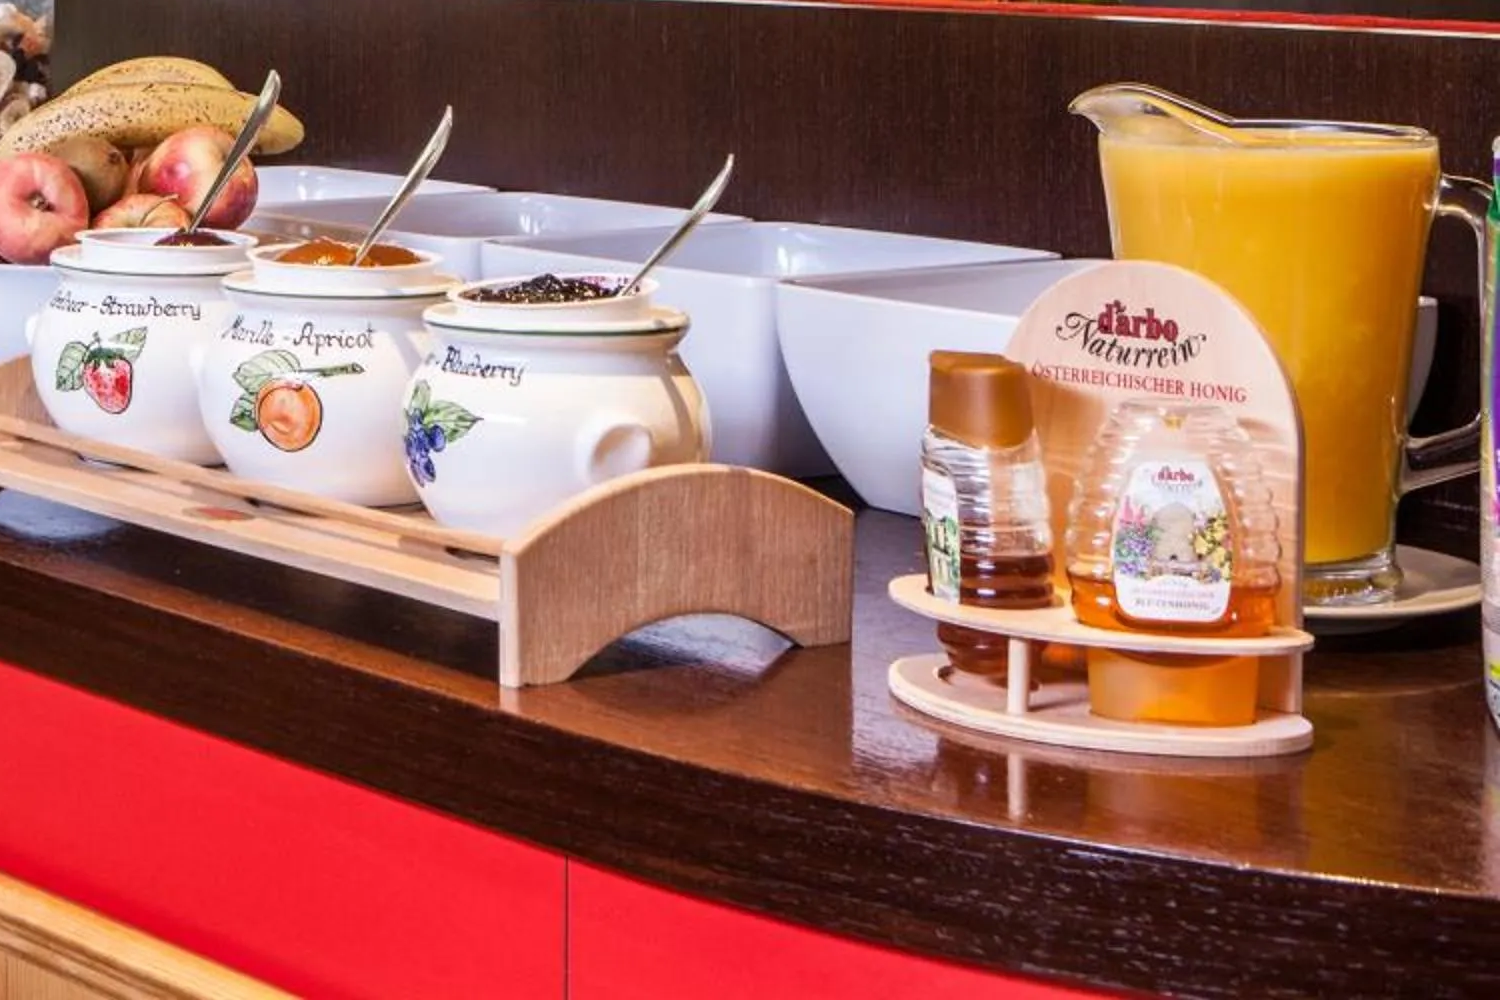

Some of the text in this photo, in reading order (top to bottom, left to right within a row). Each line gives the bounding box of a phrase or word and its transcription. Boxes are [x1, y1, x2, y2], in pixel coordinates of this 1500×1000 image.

[99, 295, 201, 321] Strawberry
[293, 321, 376, 356] Apricot
[1055, 311, 1207, 369] Naturrein
[1030, 357, 1248, 404] ÖSTERREICHISCHER HONIG
